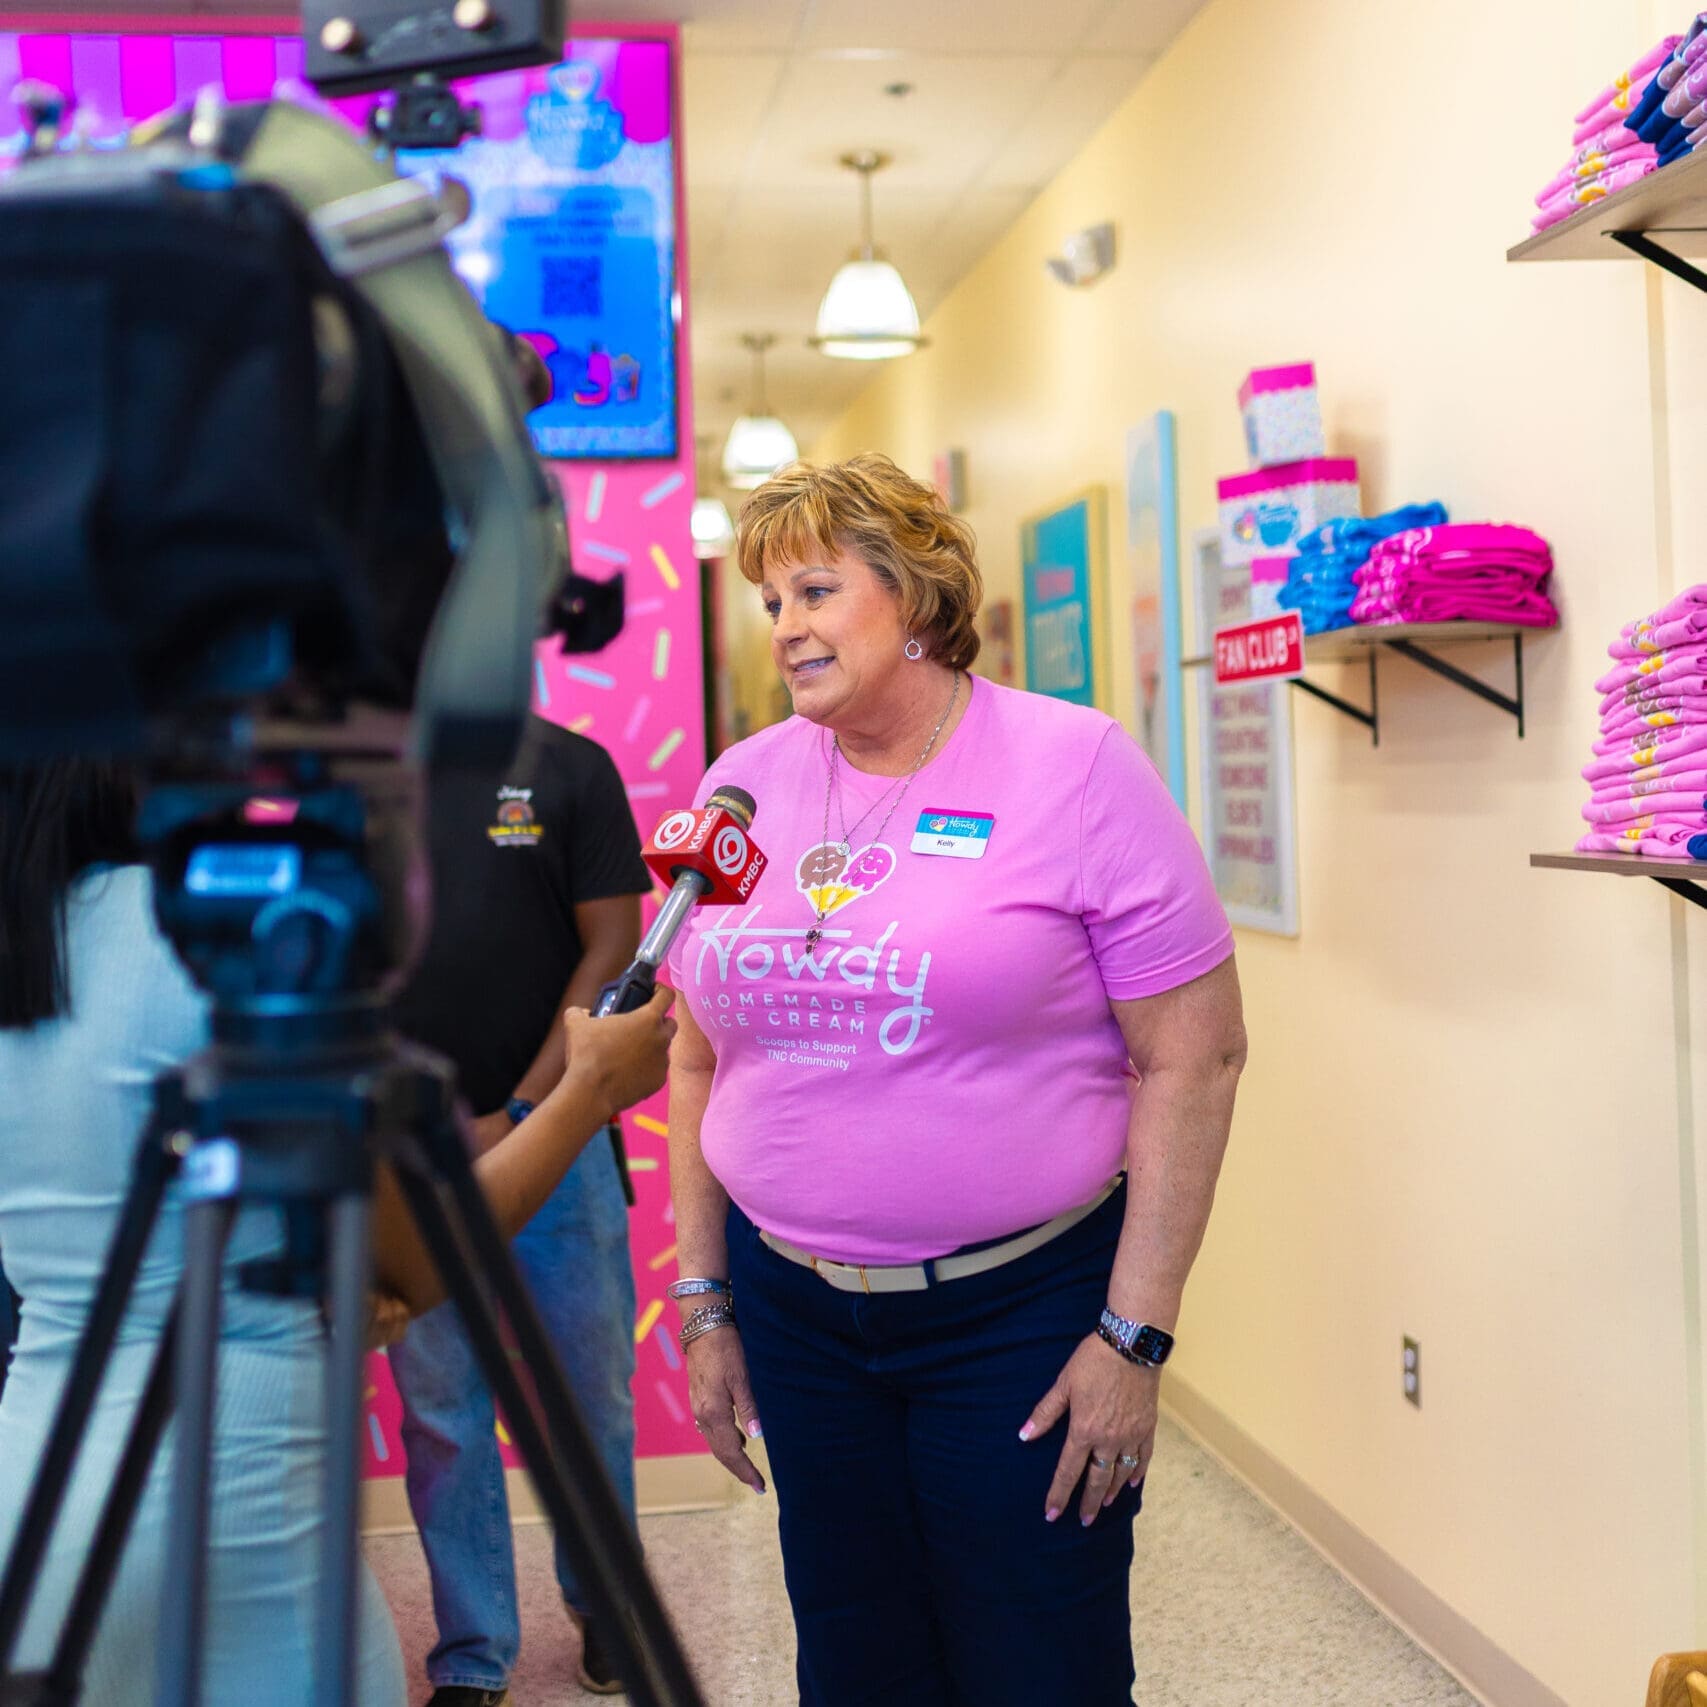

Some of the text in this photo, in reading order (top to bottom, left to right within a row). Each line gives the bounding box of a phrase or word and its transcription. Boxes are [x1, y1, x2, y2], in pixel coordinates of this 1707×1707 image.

[1217, 634, 1247, 675] FAN
[1248, 626, 1289, 671] CLUB
[688, 808, 717, 850] KMBC
[937, 840, 955, 848] Kelly
[737, 852, 764, 897] KMBC
[696, 904, 934, 1055] Howdy
[700, 992, 867, 1014] HOMEMADE
[709, 1012, 865, 1035] ICE CREAM
[755, 1035, 857, 1055] Scoops to Support
[767, 1051, 850, 1071] TNC Community
